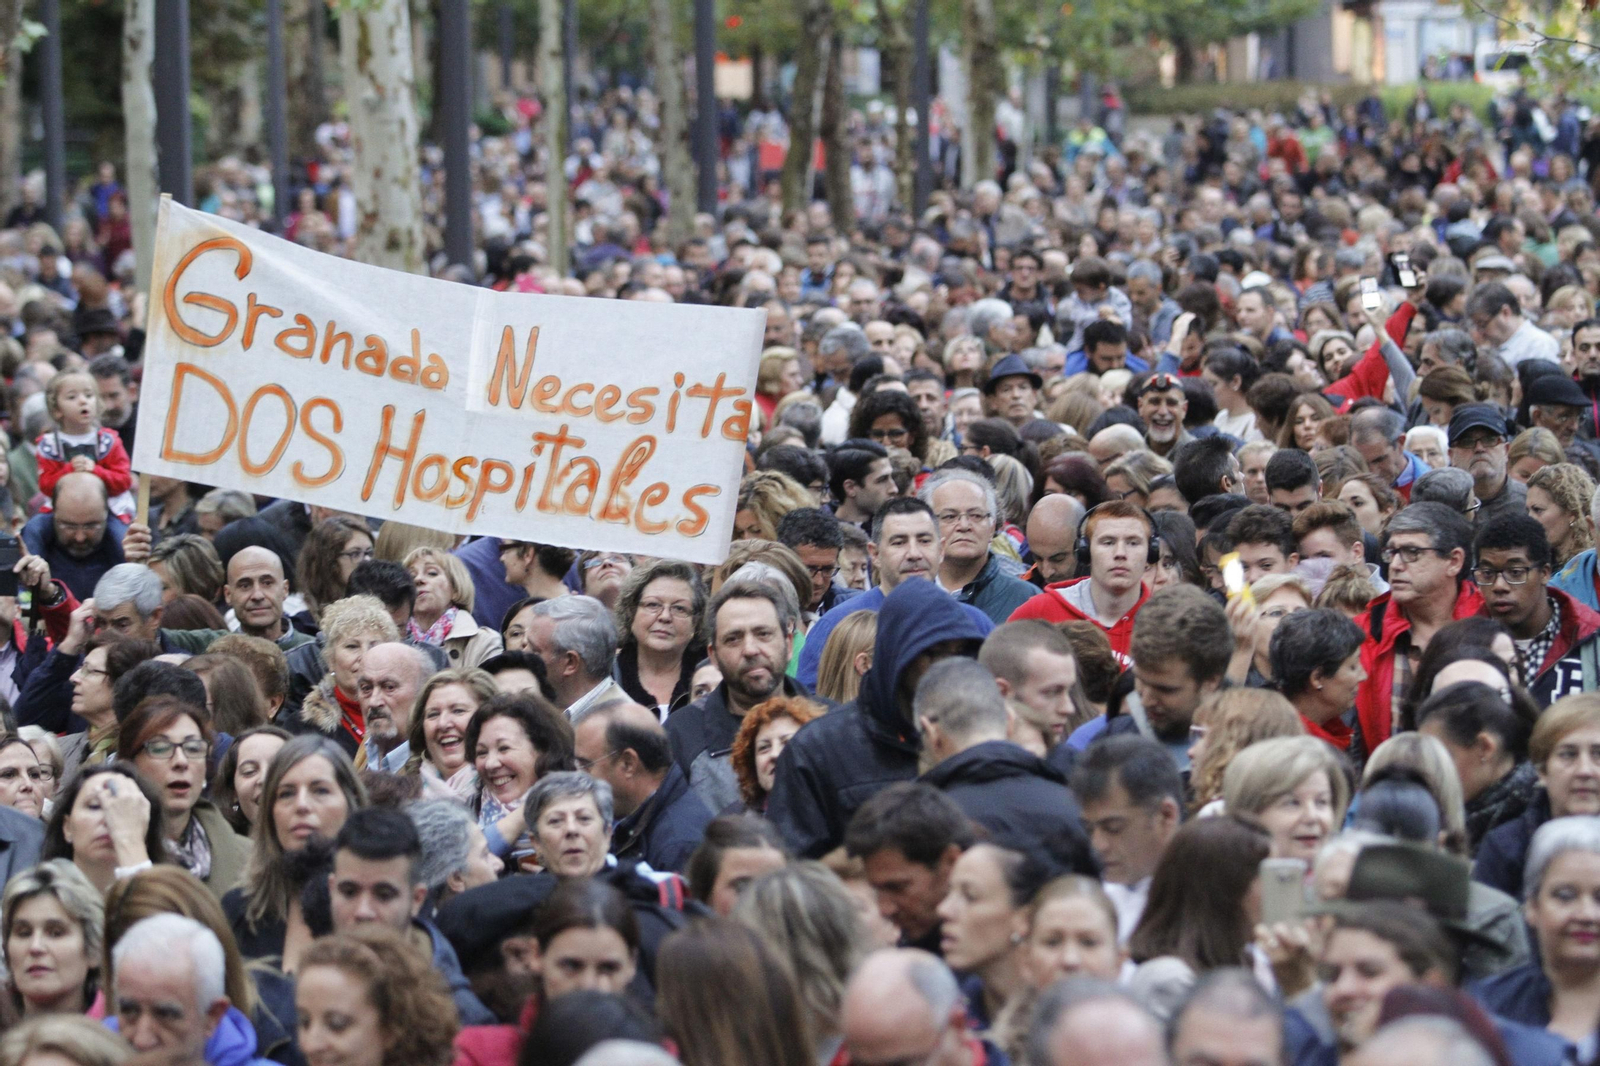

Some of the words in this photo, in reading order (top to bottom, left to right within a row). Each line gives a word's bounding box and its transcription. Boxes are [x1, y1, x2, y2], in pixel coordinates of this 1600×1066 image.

[163, 236, 449, 390] Granada
[487, 325, 752, 441] Necesita
[159, 362, 344, 488] DOS
[361, 404, 722, 538] Hospitales
